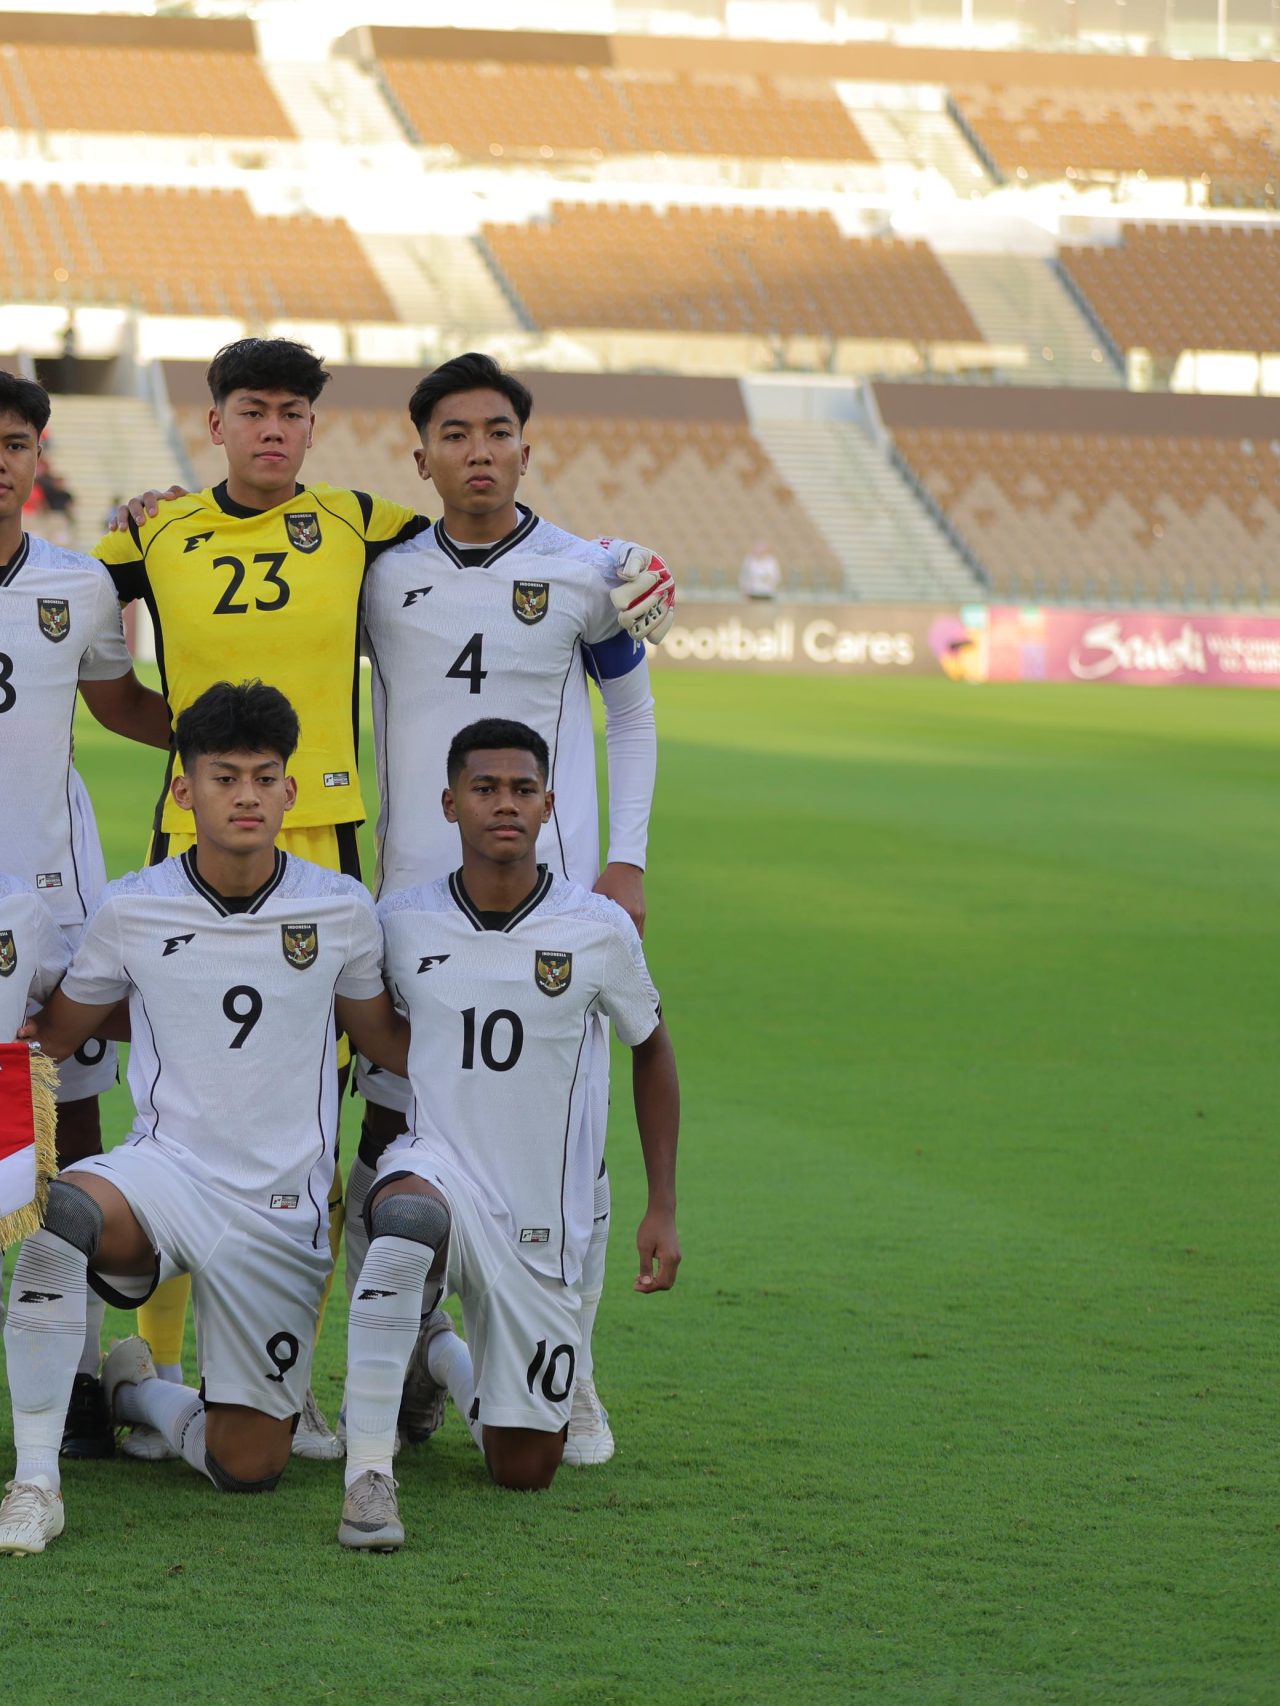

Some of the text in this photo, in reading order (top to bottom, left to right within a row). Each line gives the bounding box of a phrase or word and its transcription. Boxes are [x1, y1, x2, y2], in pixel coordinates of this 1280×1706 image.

[212, 551, 291, 615] 23
[445, 633, 488, 694] 4
[802, 618, 915, 665] Cares
[222, 984, 263, 1049] 9
[460, 1006, 524, 1072] 10
[265, 1330, 301, 1384] 9
[526, 1338, 576, 1403] 10
